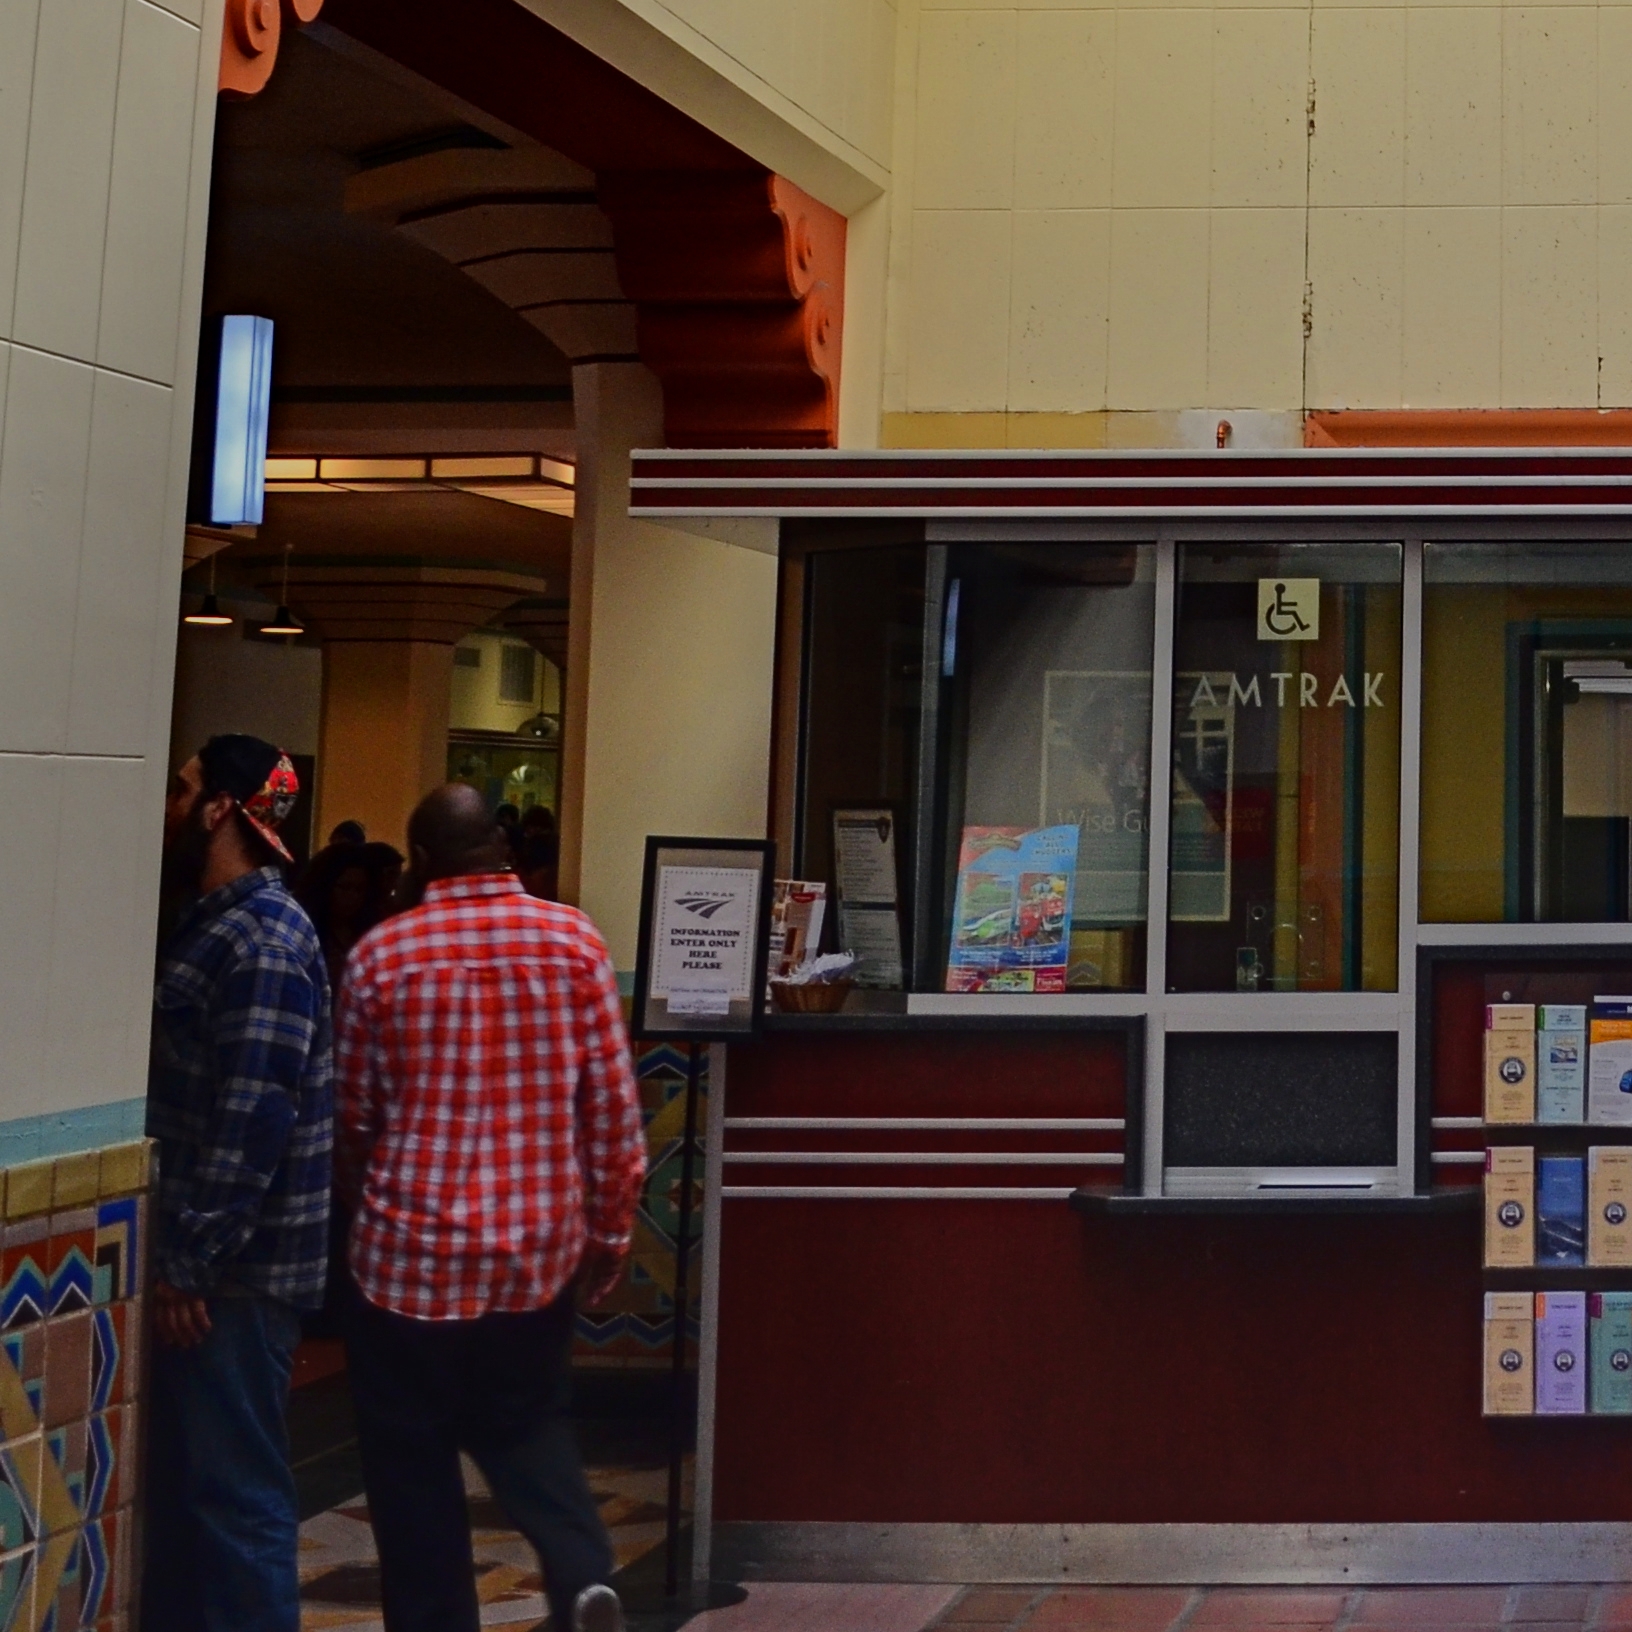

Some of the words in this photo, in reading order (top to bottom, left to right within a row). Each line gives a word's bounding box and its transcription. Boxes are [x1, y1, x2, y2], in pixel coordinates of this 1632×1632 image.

[1190, 672, 1385, 708] AMTRAK
[671, 928, 740, 937] INFORMATION
[671, 938, 705, 947] ENTER
[708, 939, 737, 948] ONLY
[689, 950, 717, 959] HERE
[682, 961, 722, 969] PLEASE
